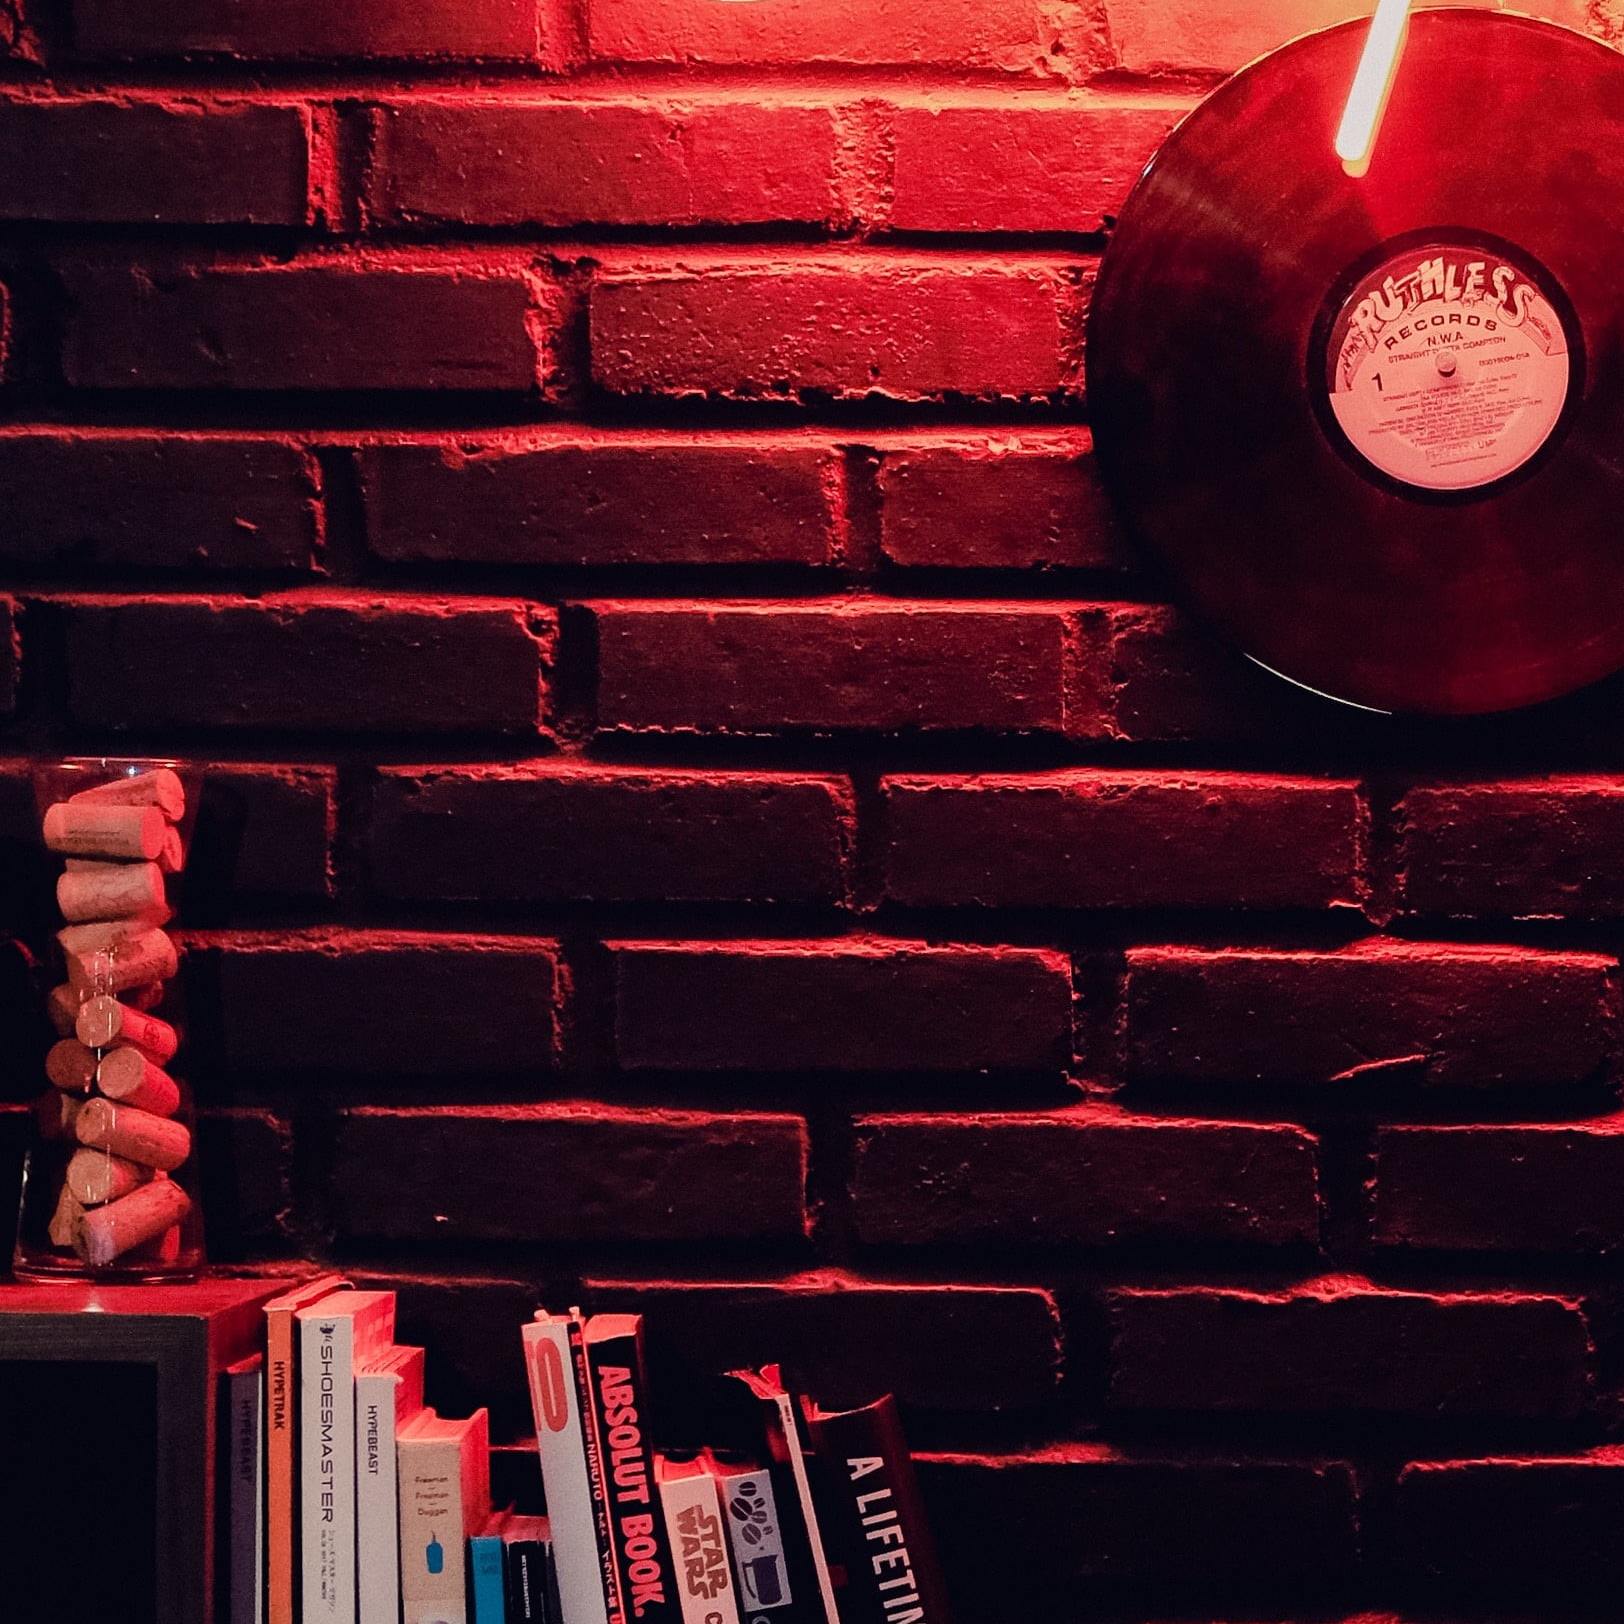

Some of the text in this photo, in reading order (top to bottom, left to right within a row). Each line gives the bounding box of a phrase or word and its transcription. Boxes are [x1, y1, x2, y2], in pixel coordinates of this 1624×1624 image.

[1349, 257, 1535, 353] RUTHLESS
[1384, 313, 1497, 350] RECORDS
[1371, 372, 1383, 392] 1
[273, 1361, 285, 1430] HYPETRAK
[321, 1345, 333, 1523] SHOESMASTER
[367, 1405, 379, 1475] HYPEBEAST
[846, 1456, 883, 1481] A
[587, 1443, 601, 1500] NARUTO
[598, 1366, 666, 1618] ABSOLUT BOOK.
[677, 1506, 710, 1600] WARS
[698, 1504, 729, 1600] STAR
